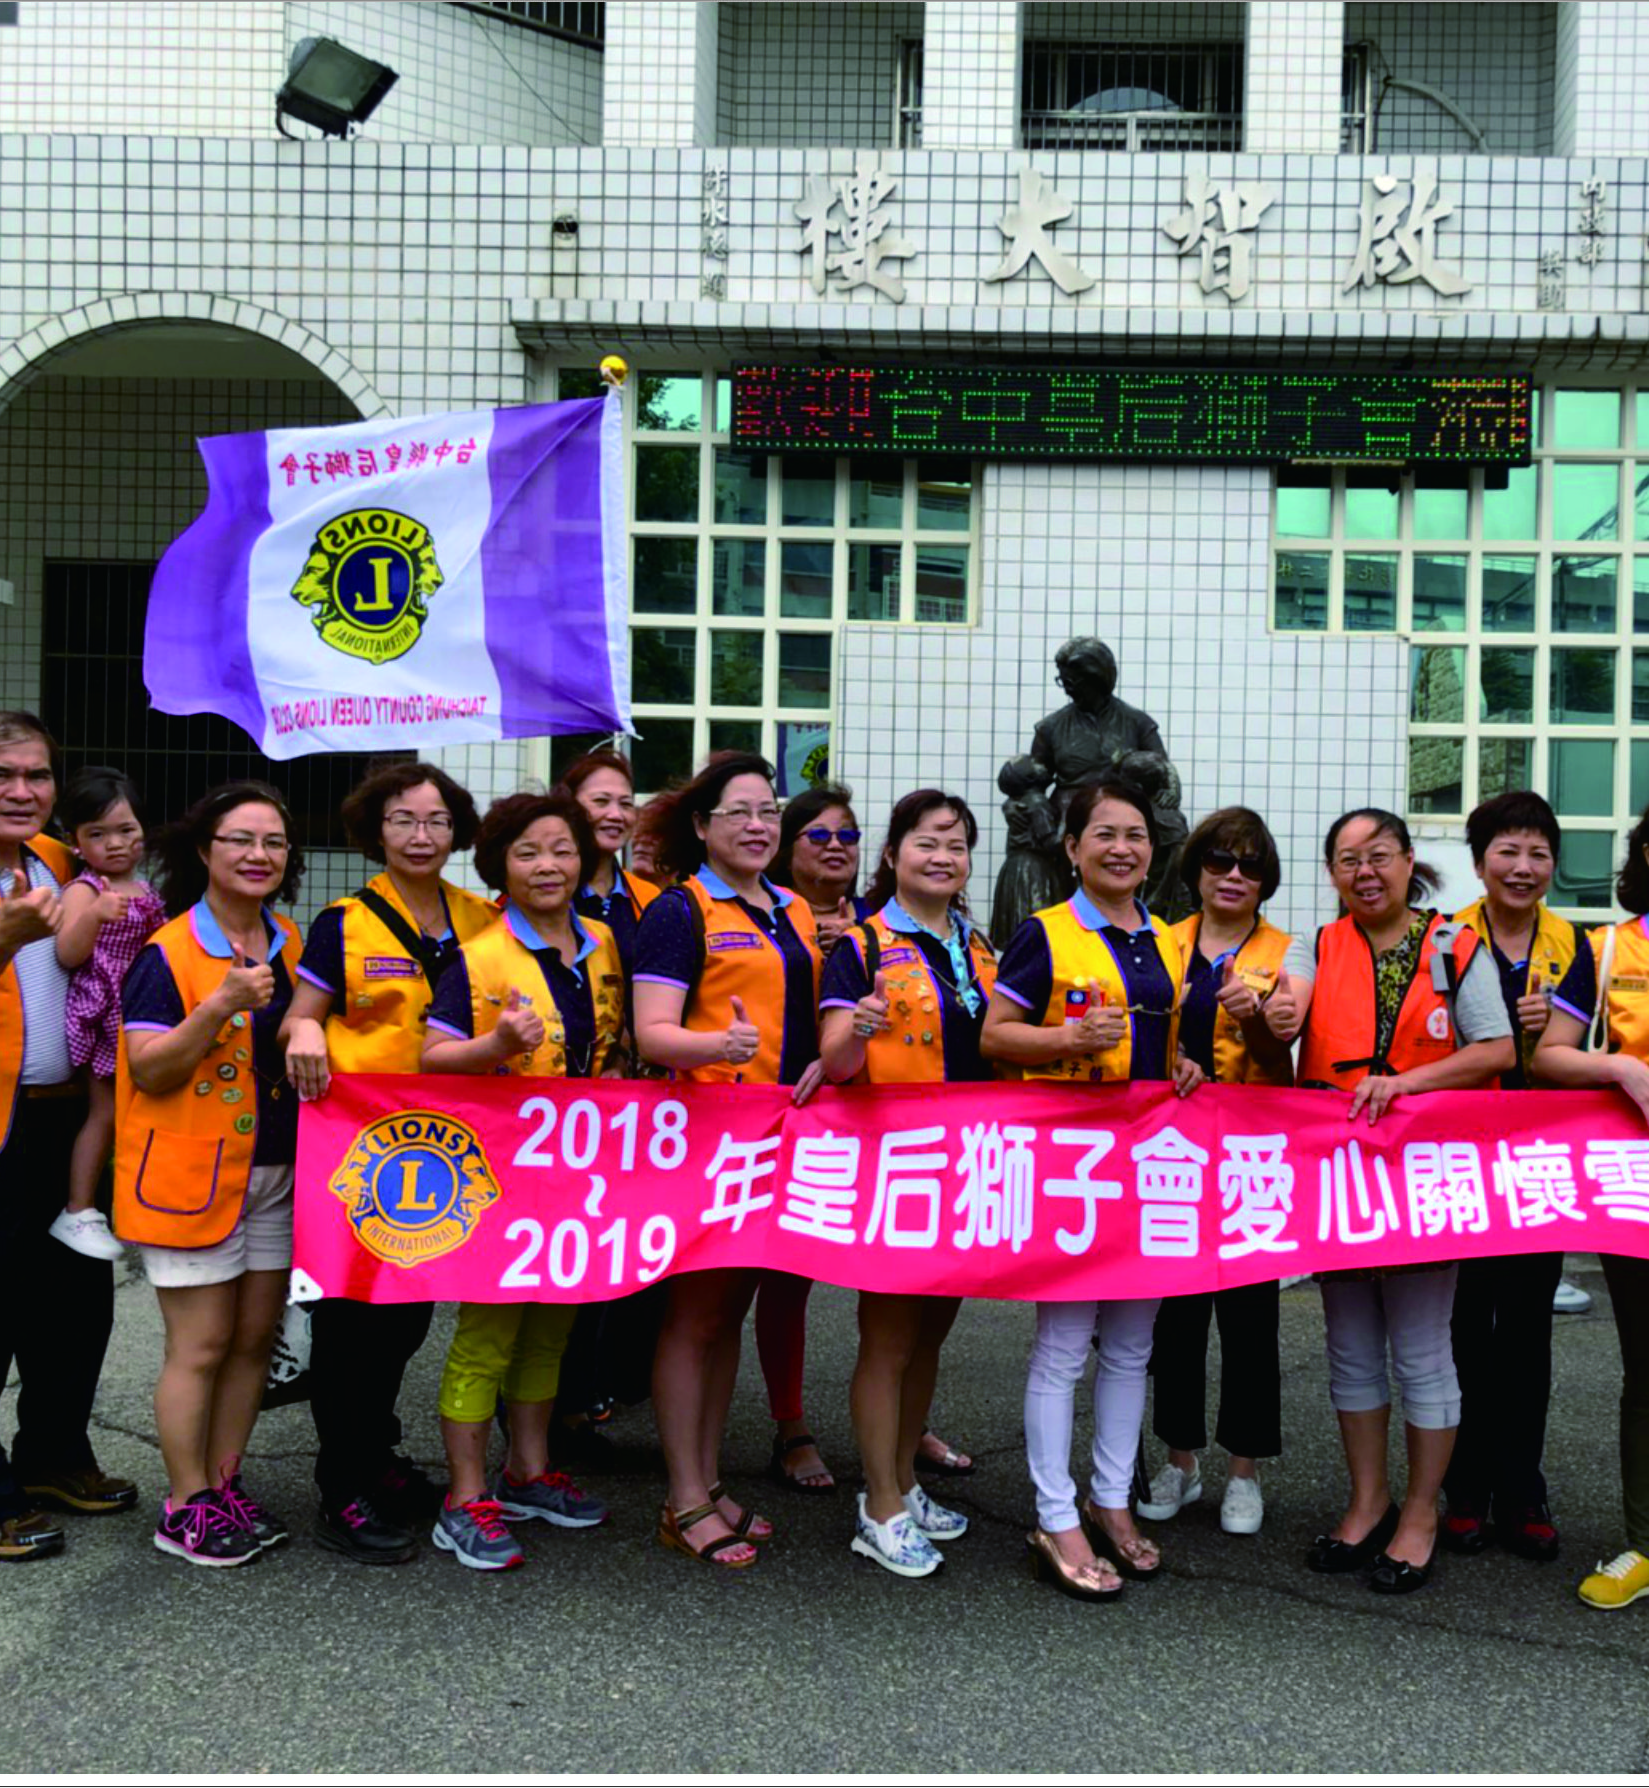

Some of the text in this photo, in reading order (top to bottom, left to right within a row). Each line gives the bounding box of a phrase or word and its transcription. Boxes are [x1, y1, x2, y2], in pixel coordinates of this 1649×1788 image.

[372, 1120, 465, 1151] LIONS
[511, 1097, 688, 1171] 2018
[395, 1160, 437, 1210] L
[366, 1223, 456, 1251] INTERNATIONAL
[499, 1215, 677, 1289] 2019
